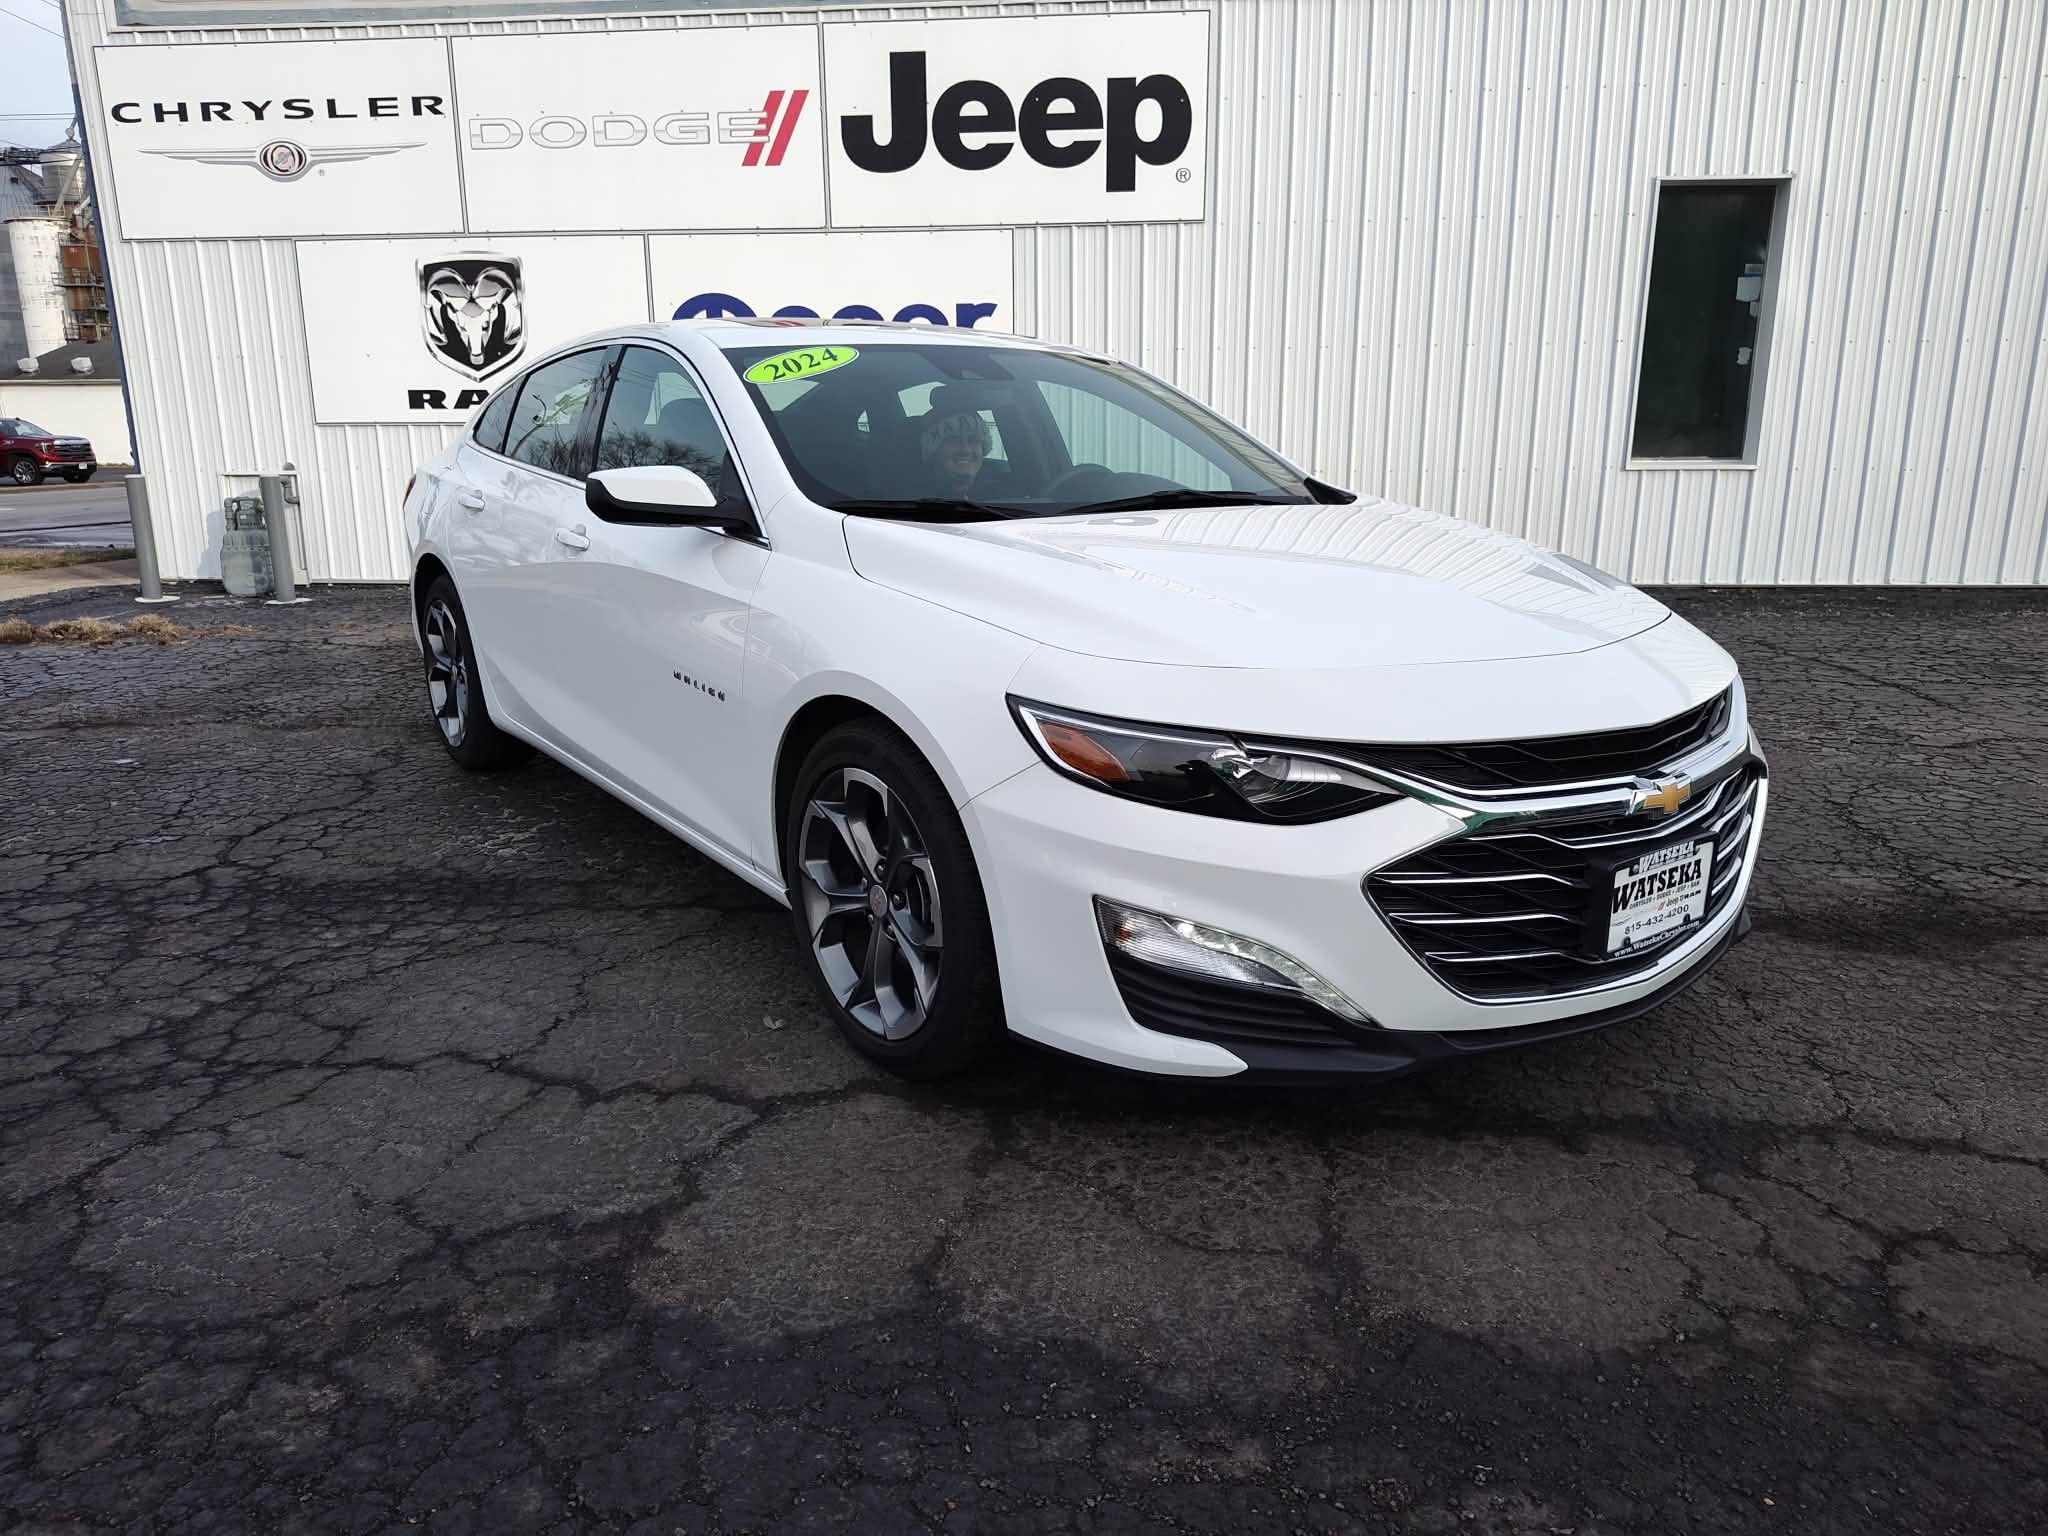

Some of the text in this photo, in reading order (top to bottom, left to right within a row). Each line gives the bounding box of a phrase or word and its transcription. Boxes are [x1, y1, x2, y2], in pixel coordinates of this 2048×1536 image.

[111, 95, 444, 124] CHRYSLER
[841, 51, 1192, 192] Jeep
[469, 111, 771, 150] DODGE
[764, 348, 838, 381] 2024
[407, 389, 490, 409] RA
[1639, 841, 1695, 873] WATSEKA
[1612, 858, 1702, 914] WATSEKA
